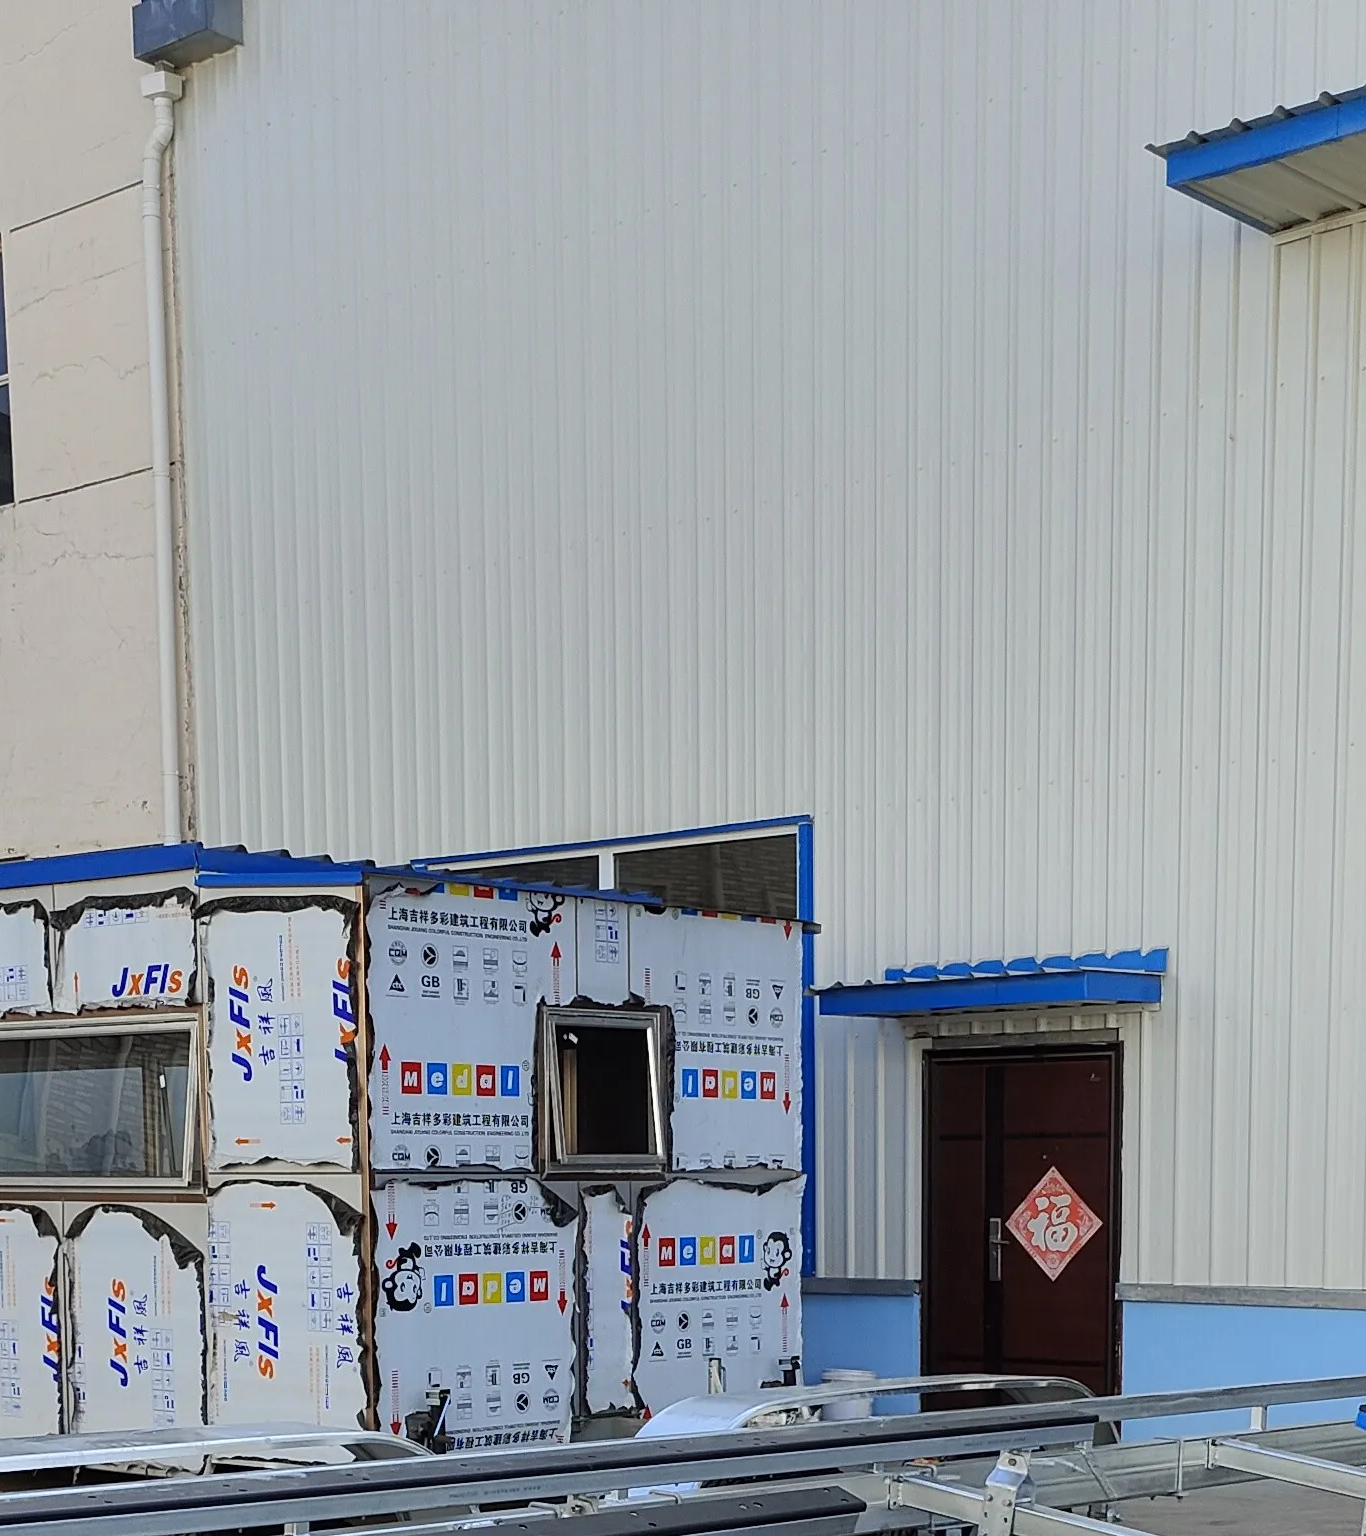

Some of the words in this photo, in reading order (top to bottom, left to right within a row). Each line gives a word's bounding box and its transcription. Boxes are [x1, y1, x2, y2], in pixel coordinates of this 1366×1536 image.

[387, 907, 527, 933] 上海吉祥多彩建筑工程有限公司
[421, 974, 440, 988] GB
[745, 988, 760, 1000] GB
[402, 1066, 516, 1093] Medal
[685, 1072, 775, 1097] Medal
[390, 1111, 530, 1128] 上海吉祥多彩建筑工程有限公司
[391, 1152, 411, 1161] CQM
[511, 1183, 528, 1194] GB
[1027, 1193, 1078, 1252] 福
[424, 1240, 558, 1258] 上海吉祥多彩建筑工程有限公司
[660, 1237, 752, 1263] Medal
[437, 1274, 547, 1304] Medal
[650, 1278, 762, 1296] 上海吉祥多彩建筑工程有限公司
[677, 1338, 692, 1350] GB
[512, 1372, 531, 1385] GB
